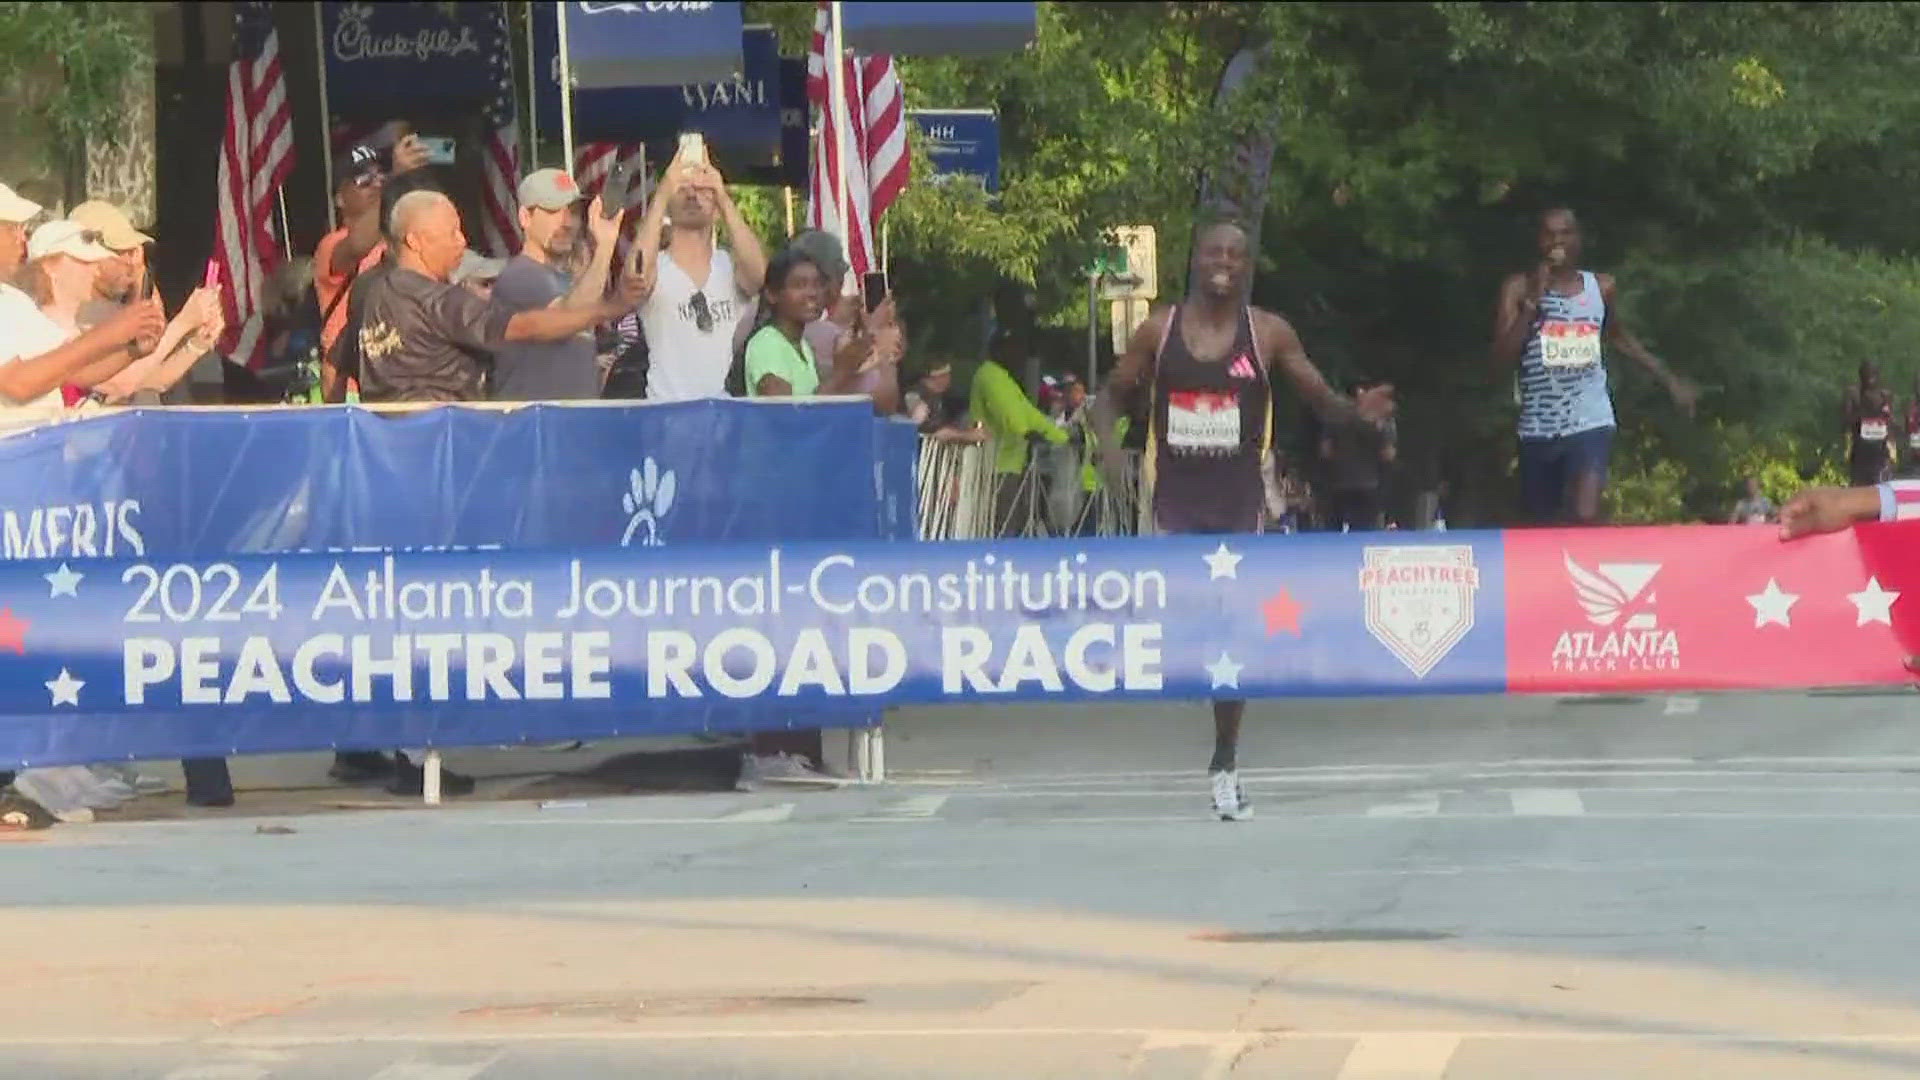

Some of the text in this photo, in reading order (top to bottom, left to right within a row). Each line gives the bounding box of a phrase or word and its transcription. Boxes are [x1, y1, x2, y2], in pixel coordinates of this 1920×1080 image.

[121, 548, 1167, 623] 2024 Atlanta Journal-Constitution
[1361, 564, 1477, 591] PEACHTREE
[1552, 630, 1680, 659] ATLANTA
[122, 623, 1163, 705] PEACHTREE ROAD RACE
[1552, 657, 1680, 672] TRACK CLUB
